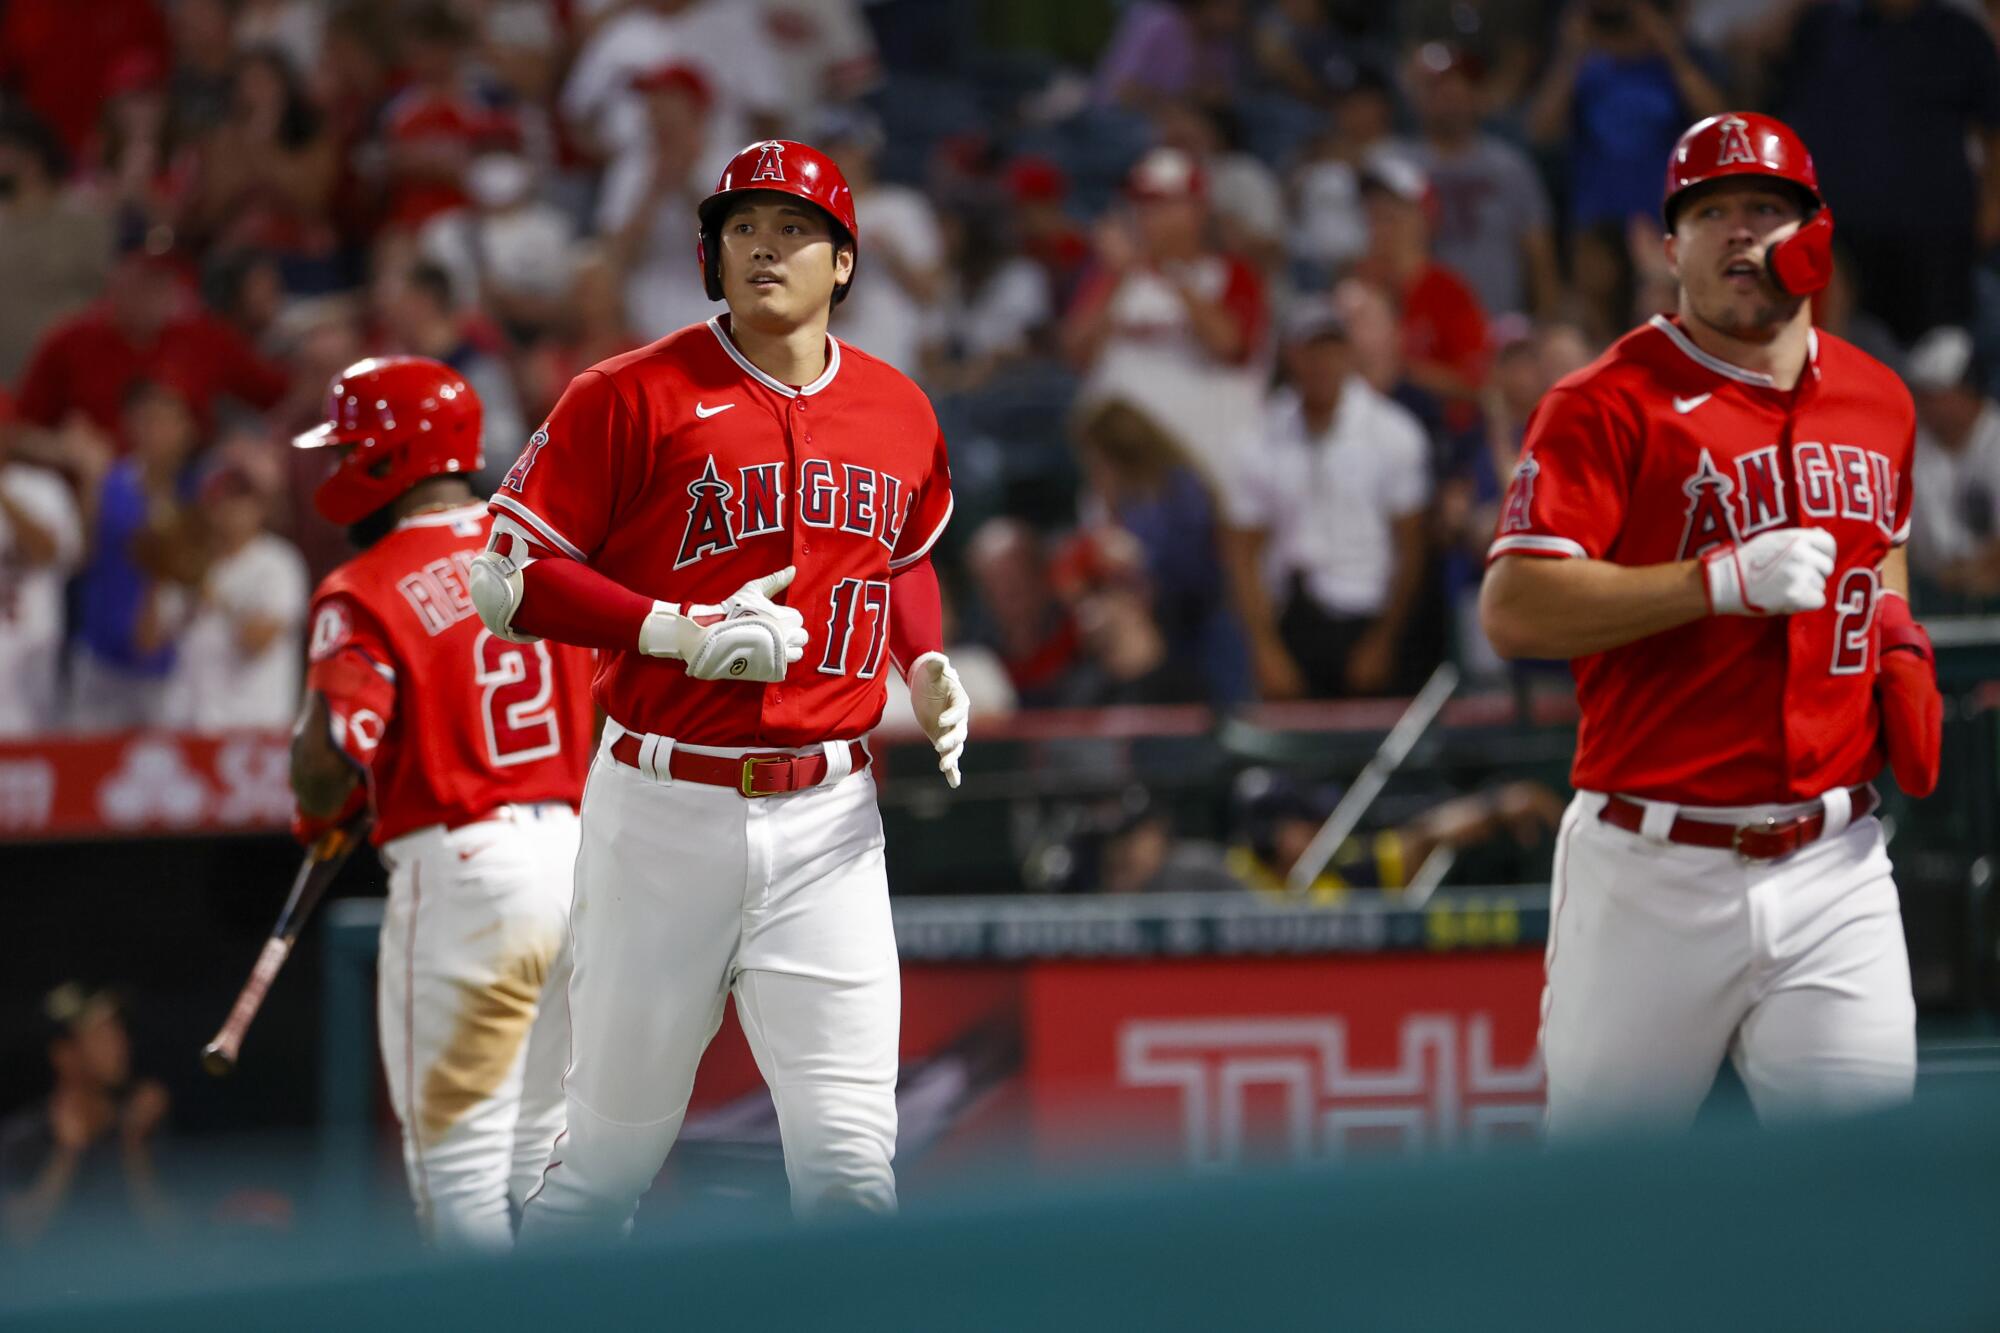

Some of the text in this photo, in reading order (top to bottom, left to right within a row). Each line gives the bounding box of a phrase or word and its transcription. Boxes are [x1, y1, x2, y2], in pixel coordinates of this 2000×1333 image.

[751, 140, 785, 181] A
[1716, 115, 1757, 166] A
[502, 422, 550, 493] A
[1502, 451, 1540, 533] A
[1676, 442, 1899, 562] ANGEL
[673, 454, 913, 571] ANGEL
[818, 577, 890, 679] 17
[473, 626, 561, 769] 2
